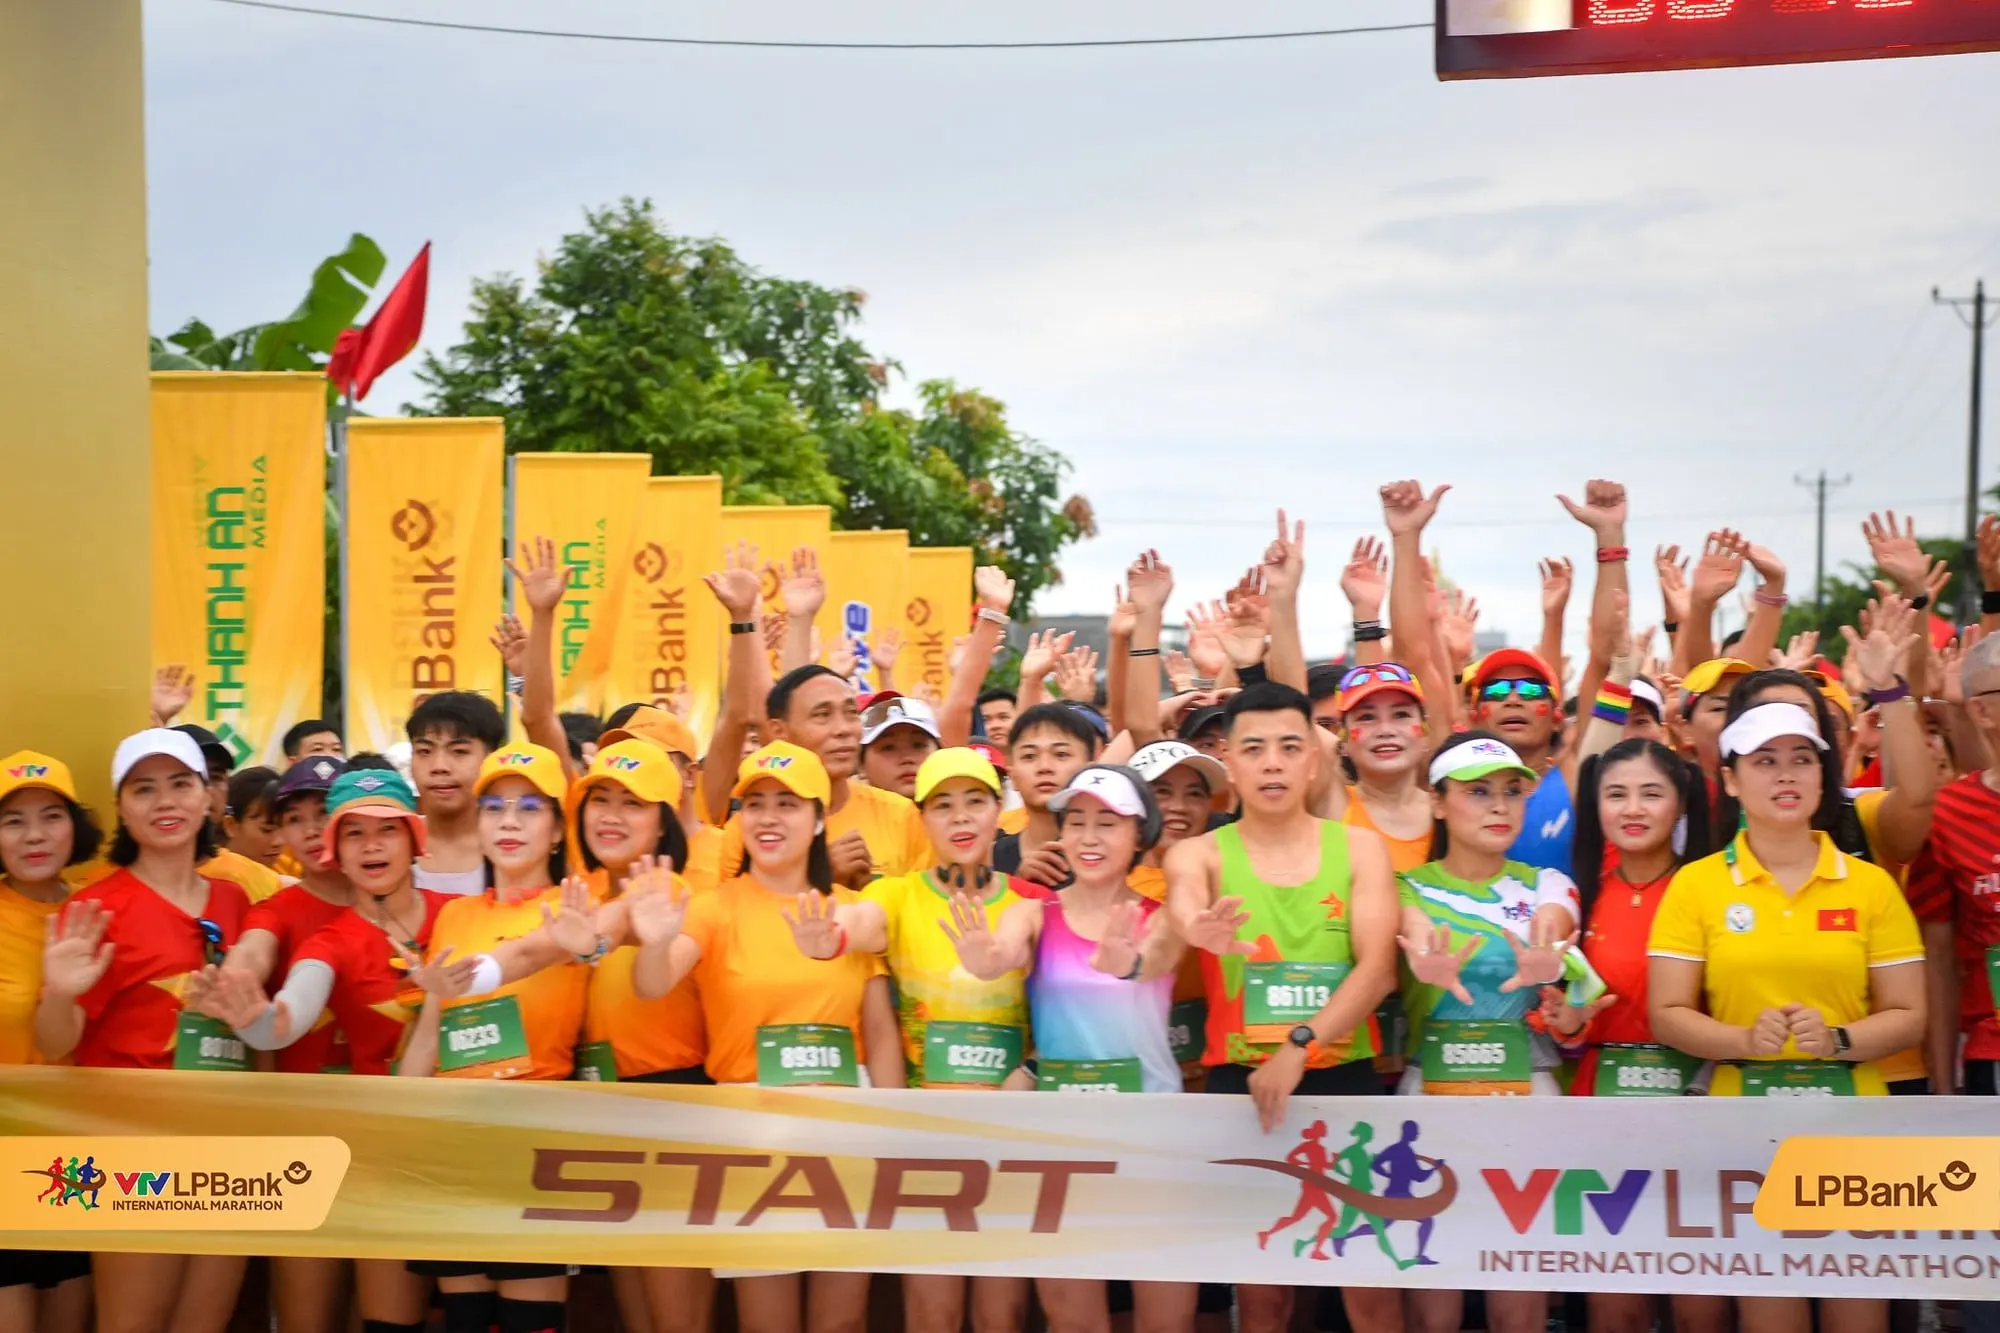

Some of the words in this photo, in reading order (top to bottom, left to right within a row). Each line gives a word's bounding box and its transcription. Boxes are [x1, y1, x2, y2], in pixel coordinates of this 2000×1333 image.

[206, 486, 247, 550] AN
[251, 454, 268, 549] MEDIA
[205, 562, 247, 721] THANH
[521, 1147, 1118, 1234] START
[1480, 1168, 1653, 1235] VTV
[1479, 1249, 1774, 1277] INTERNATIONAL
